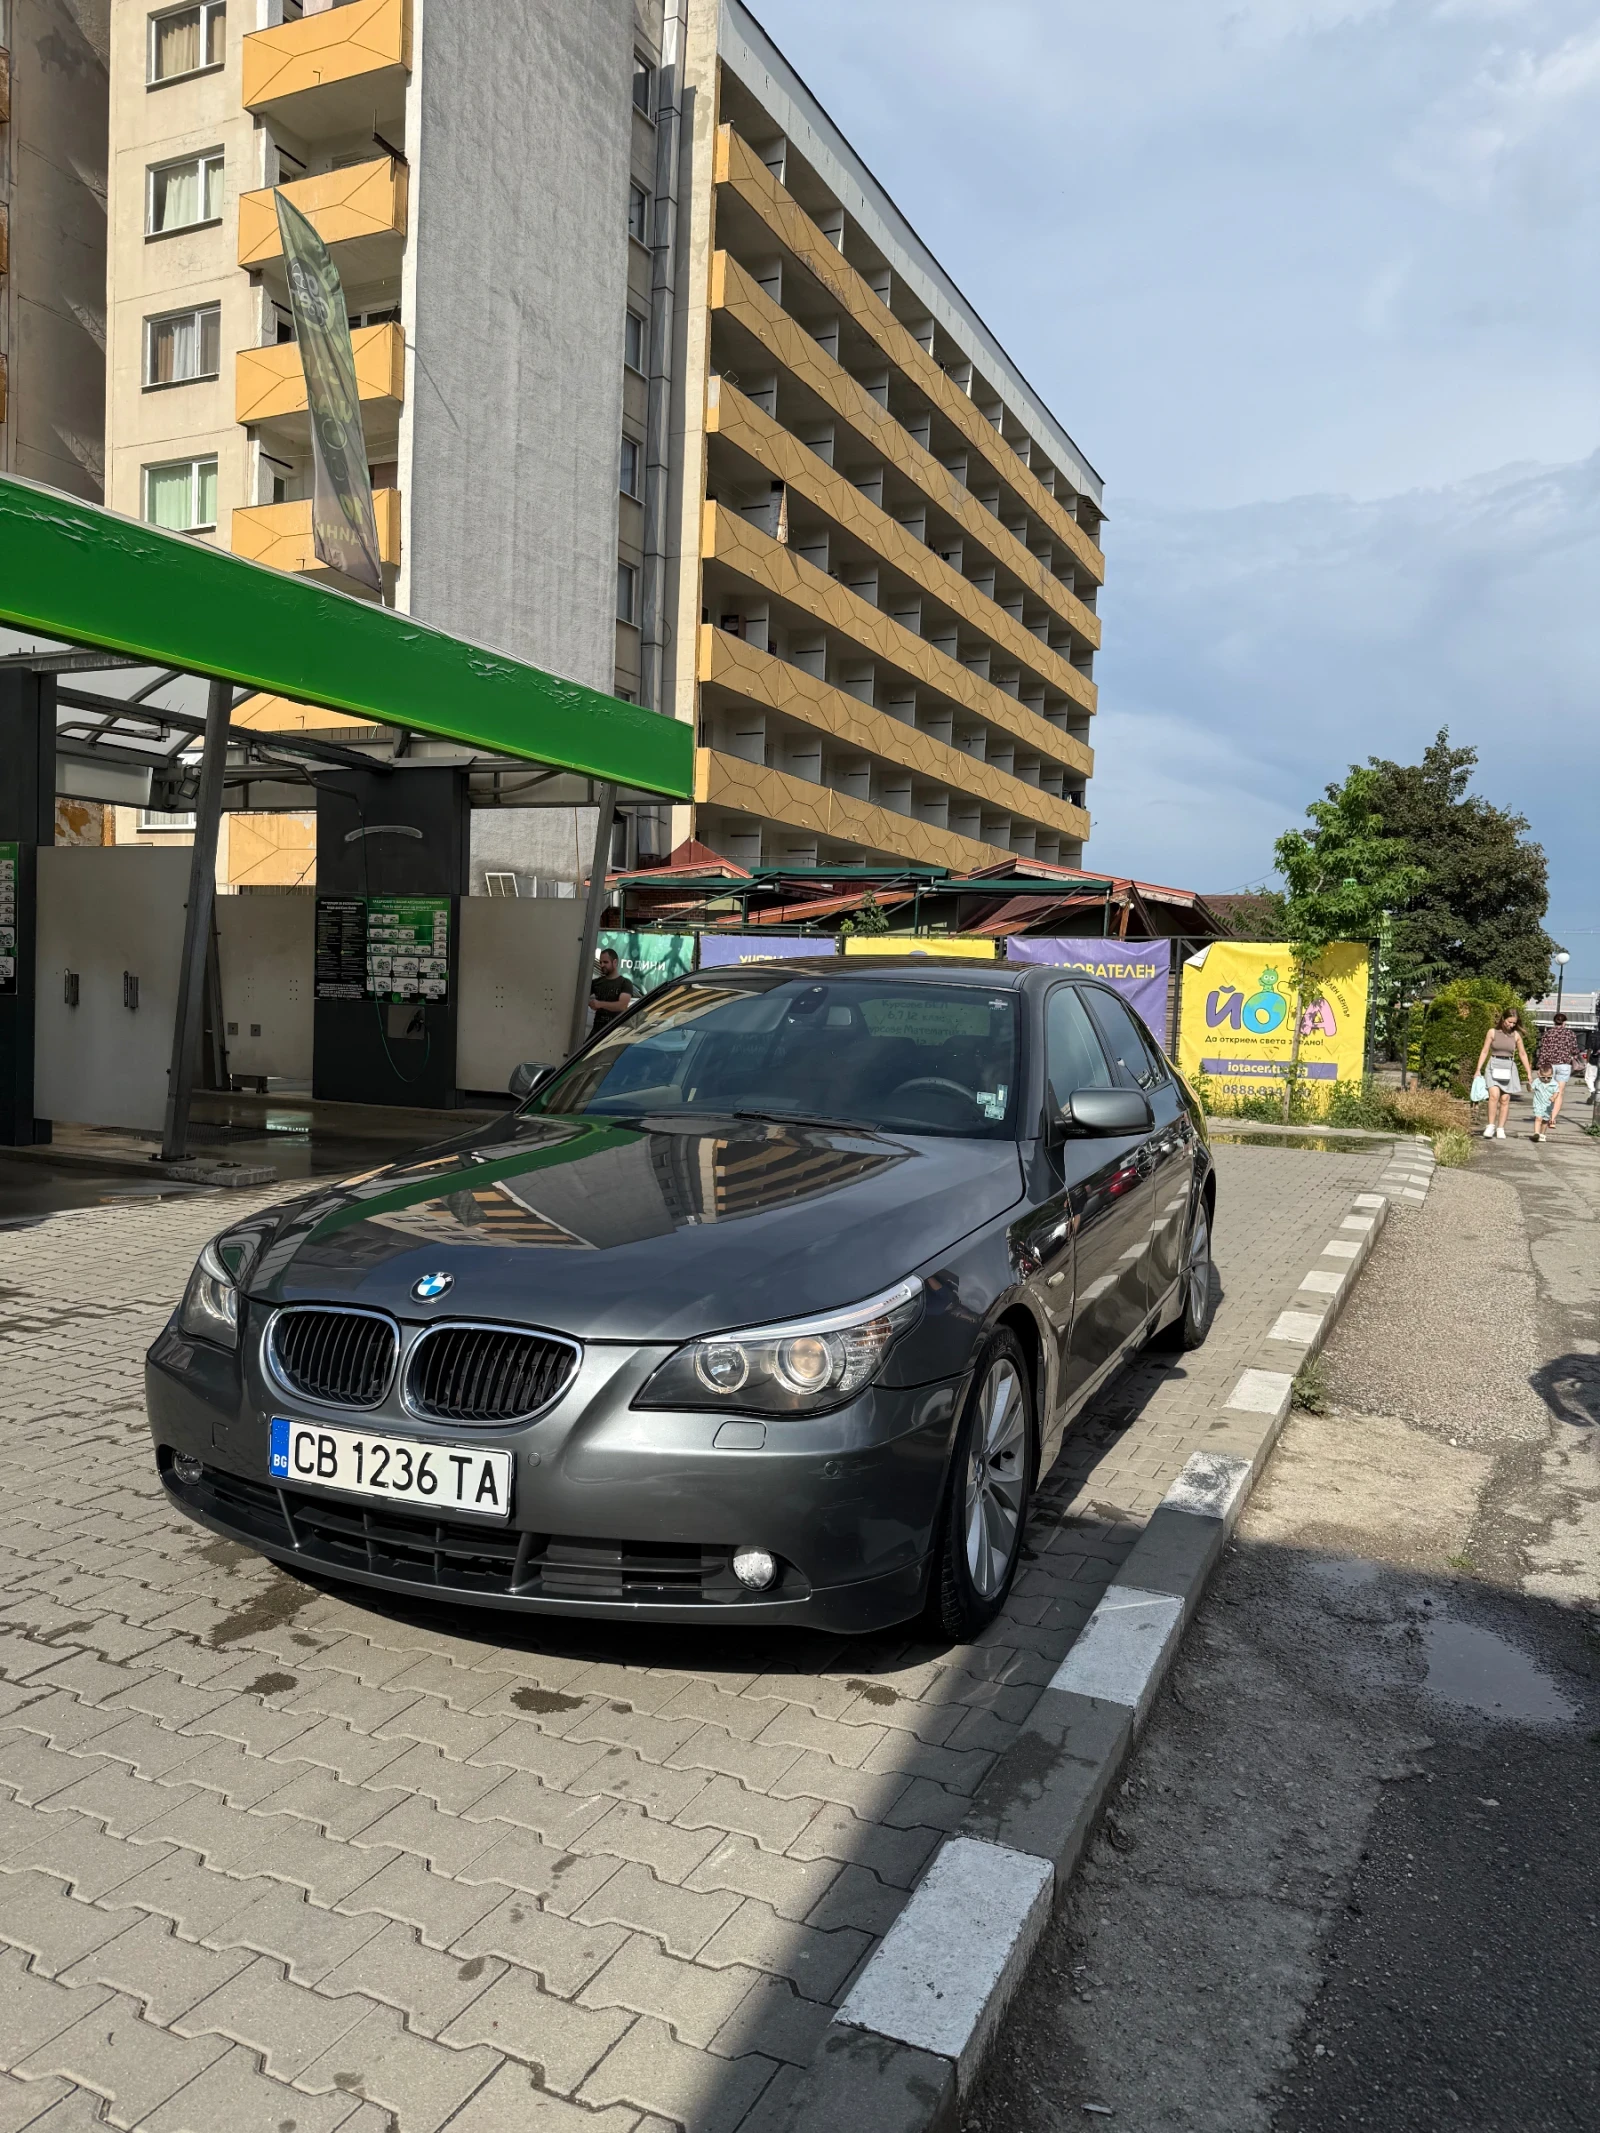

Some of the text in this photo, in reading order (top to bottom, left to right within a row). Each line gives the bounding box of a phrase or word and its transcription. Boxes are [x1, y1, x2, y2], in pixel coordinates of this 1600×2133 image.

[620, 959, 666, 971] ГОДИНИ
[1204, 1035, 1217, 1043] Да
[1219, 1037, 1258, 1045] открием
[1259, 1037, 1287, 1045] света
[1222, 1084, 1255, 1096] 0888
[273, 1431, 500, 1506] BG CB 1236 TA
